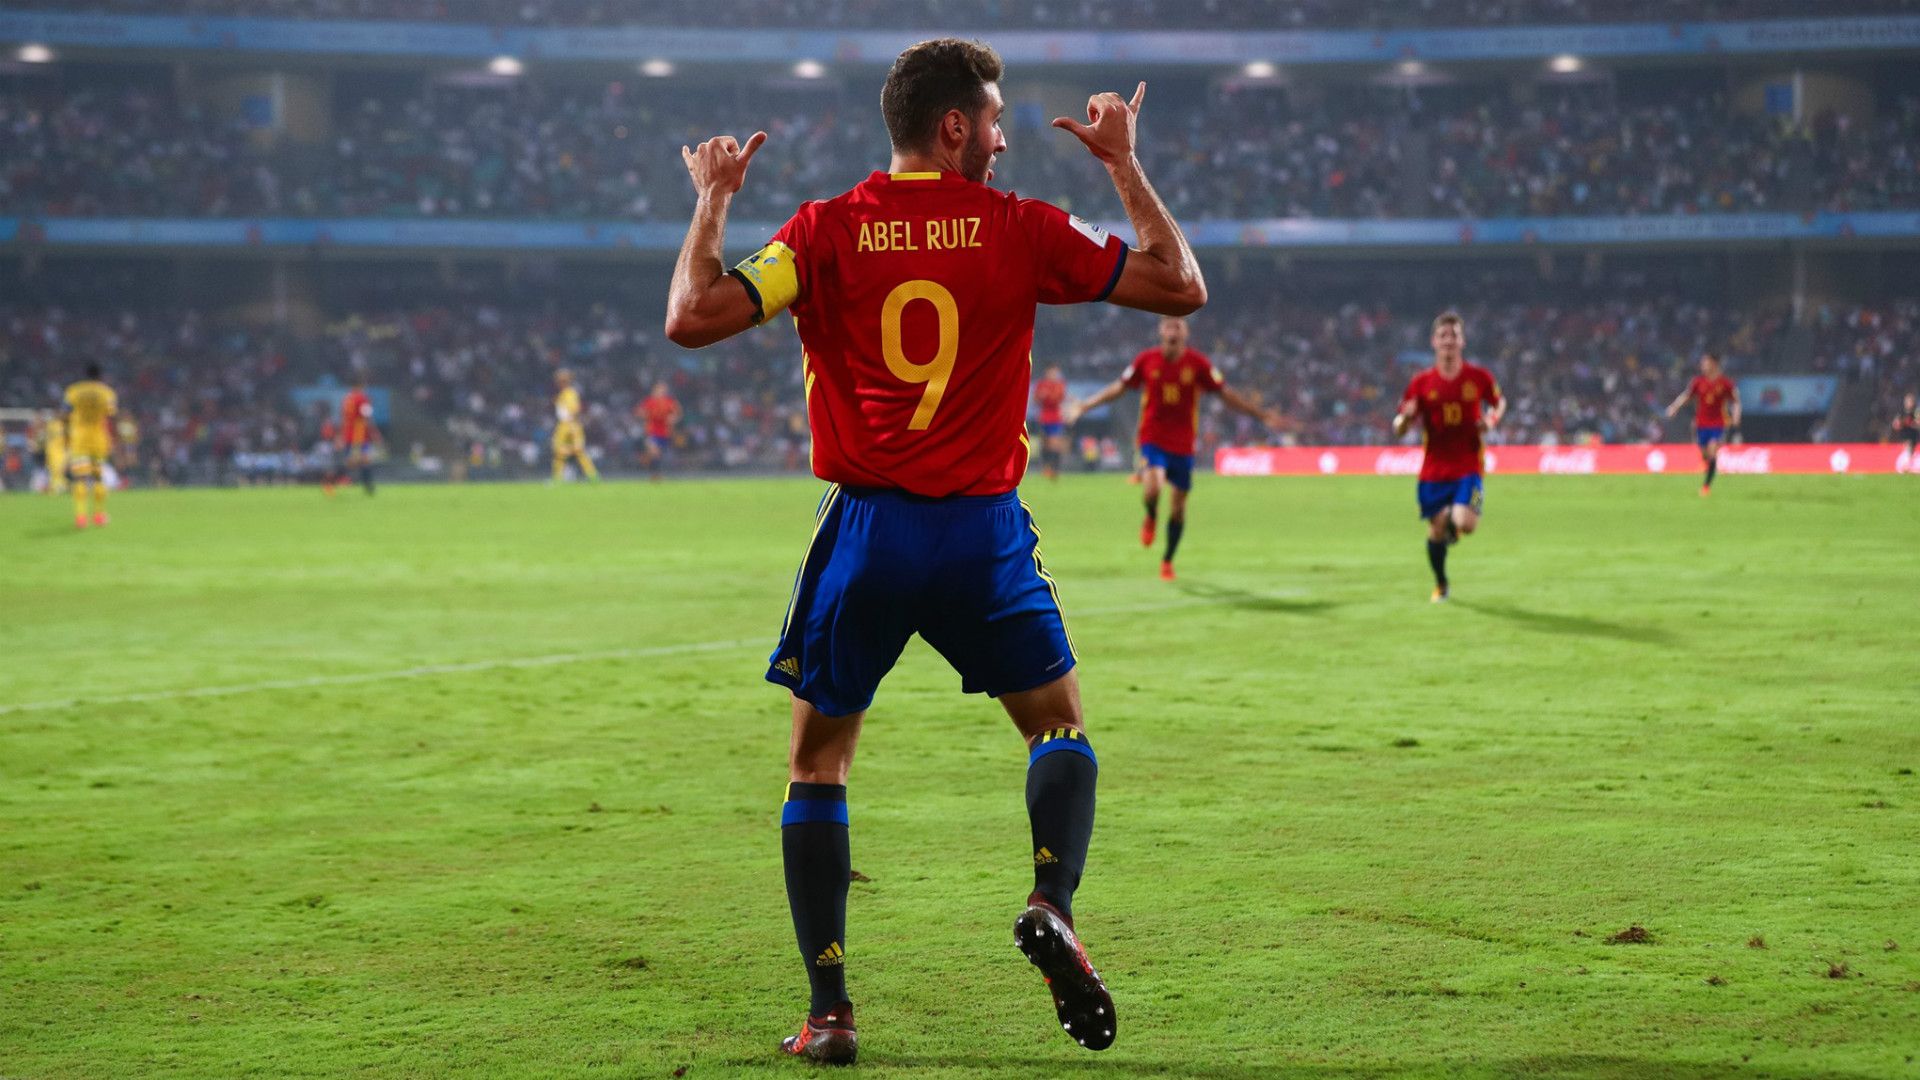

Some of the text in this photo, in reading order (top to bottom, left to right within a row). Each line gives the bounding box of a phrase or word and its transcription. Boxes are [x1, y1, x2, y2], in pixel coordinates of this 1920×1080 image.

[857, 217, 983, 252] ABEL RUIZ
[881, 279, 960, 431] 9
[1443, 401, 1462, 426] 10
